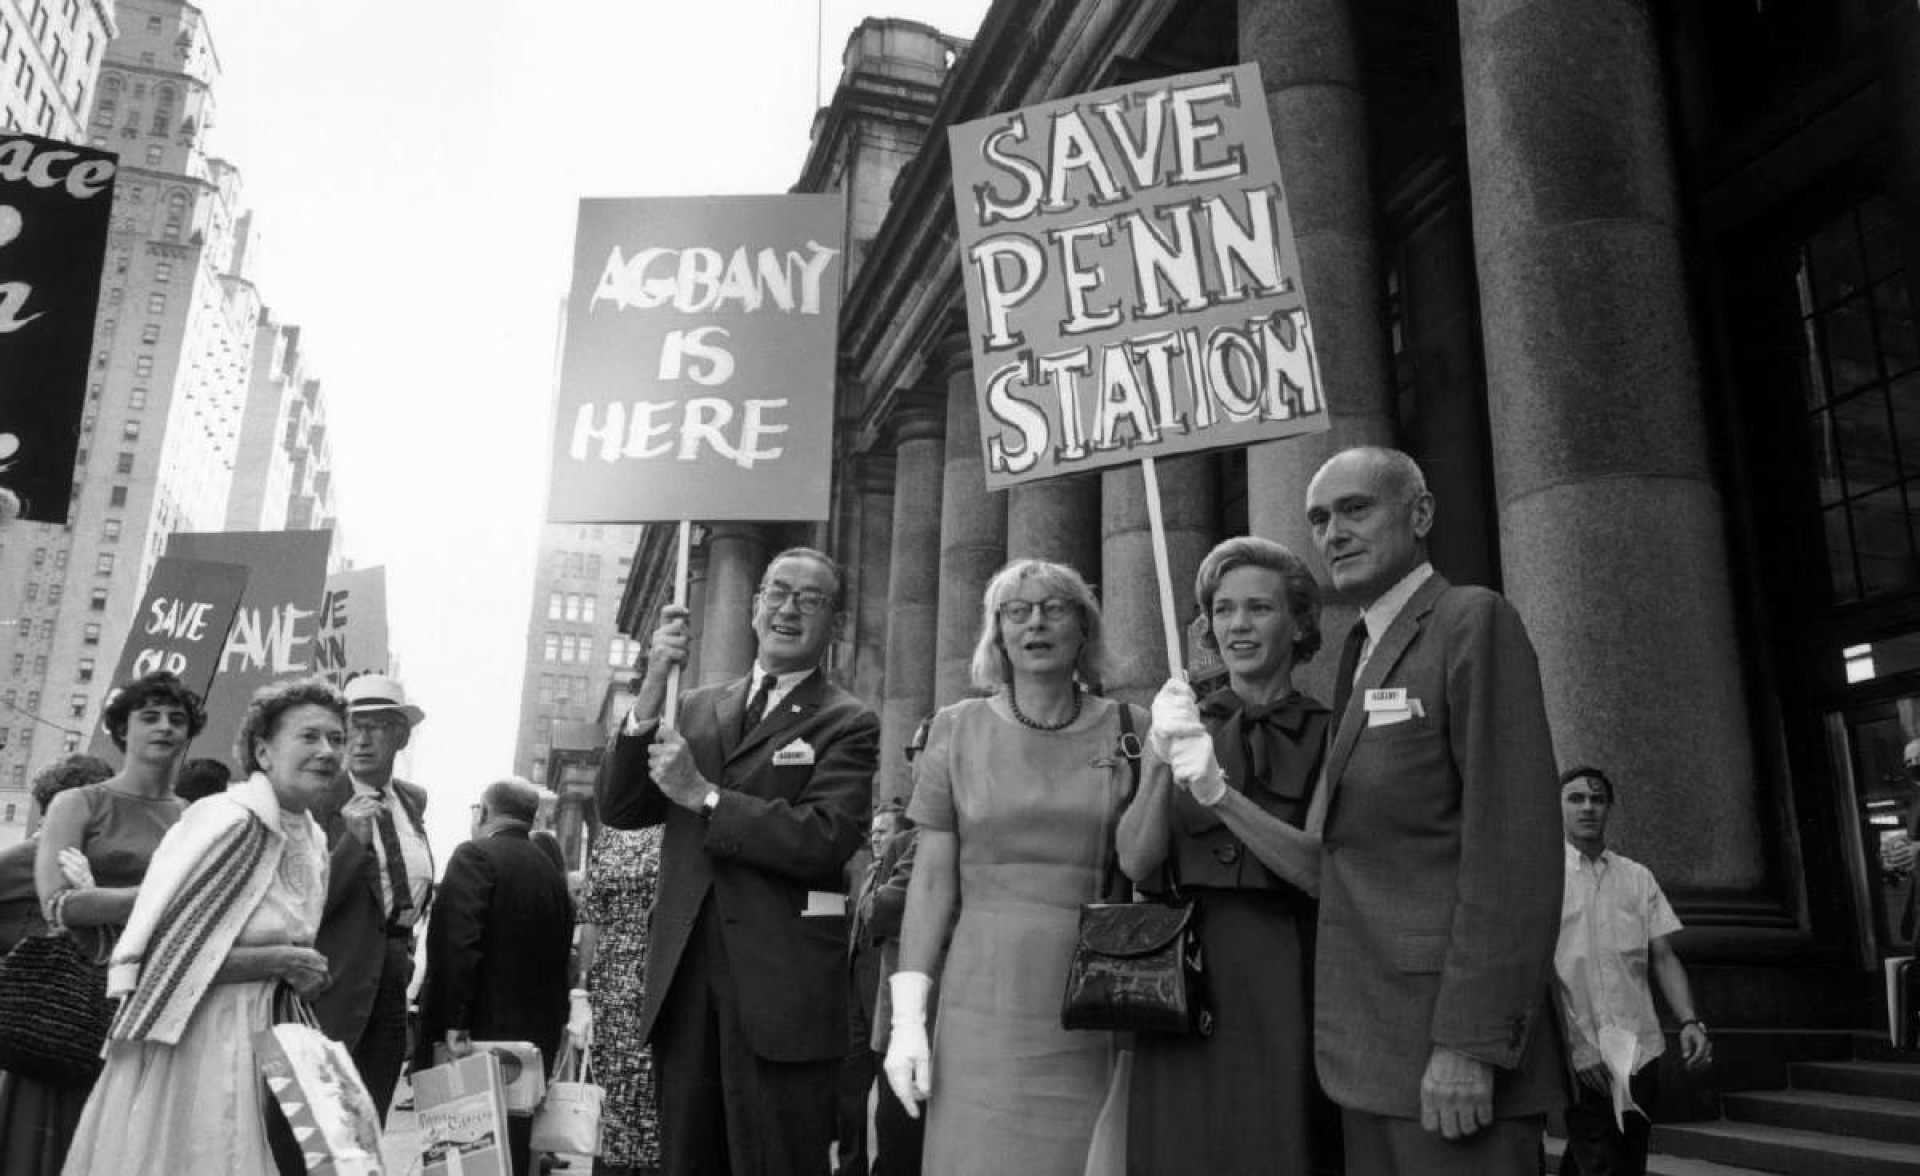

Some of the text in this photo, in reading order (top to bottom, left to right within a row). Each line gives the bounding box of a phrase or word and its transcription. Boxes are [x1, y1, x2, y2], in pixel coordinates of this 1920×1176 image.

[973, 73, 1246, 225] SAVE
[590, 240, 840, 319] AGBANY
[969, 183, 1293, 352] PENN
[658, 325, 735, 385] IS
[986, 308, 1324, 475] STATION
[569, 397, 789, 470] HERE
[146, 597, 214, 641] SAVE
[218, 602, 315, 673] AVE
